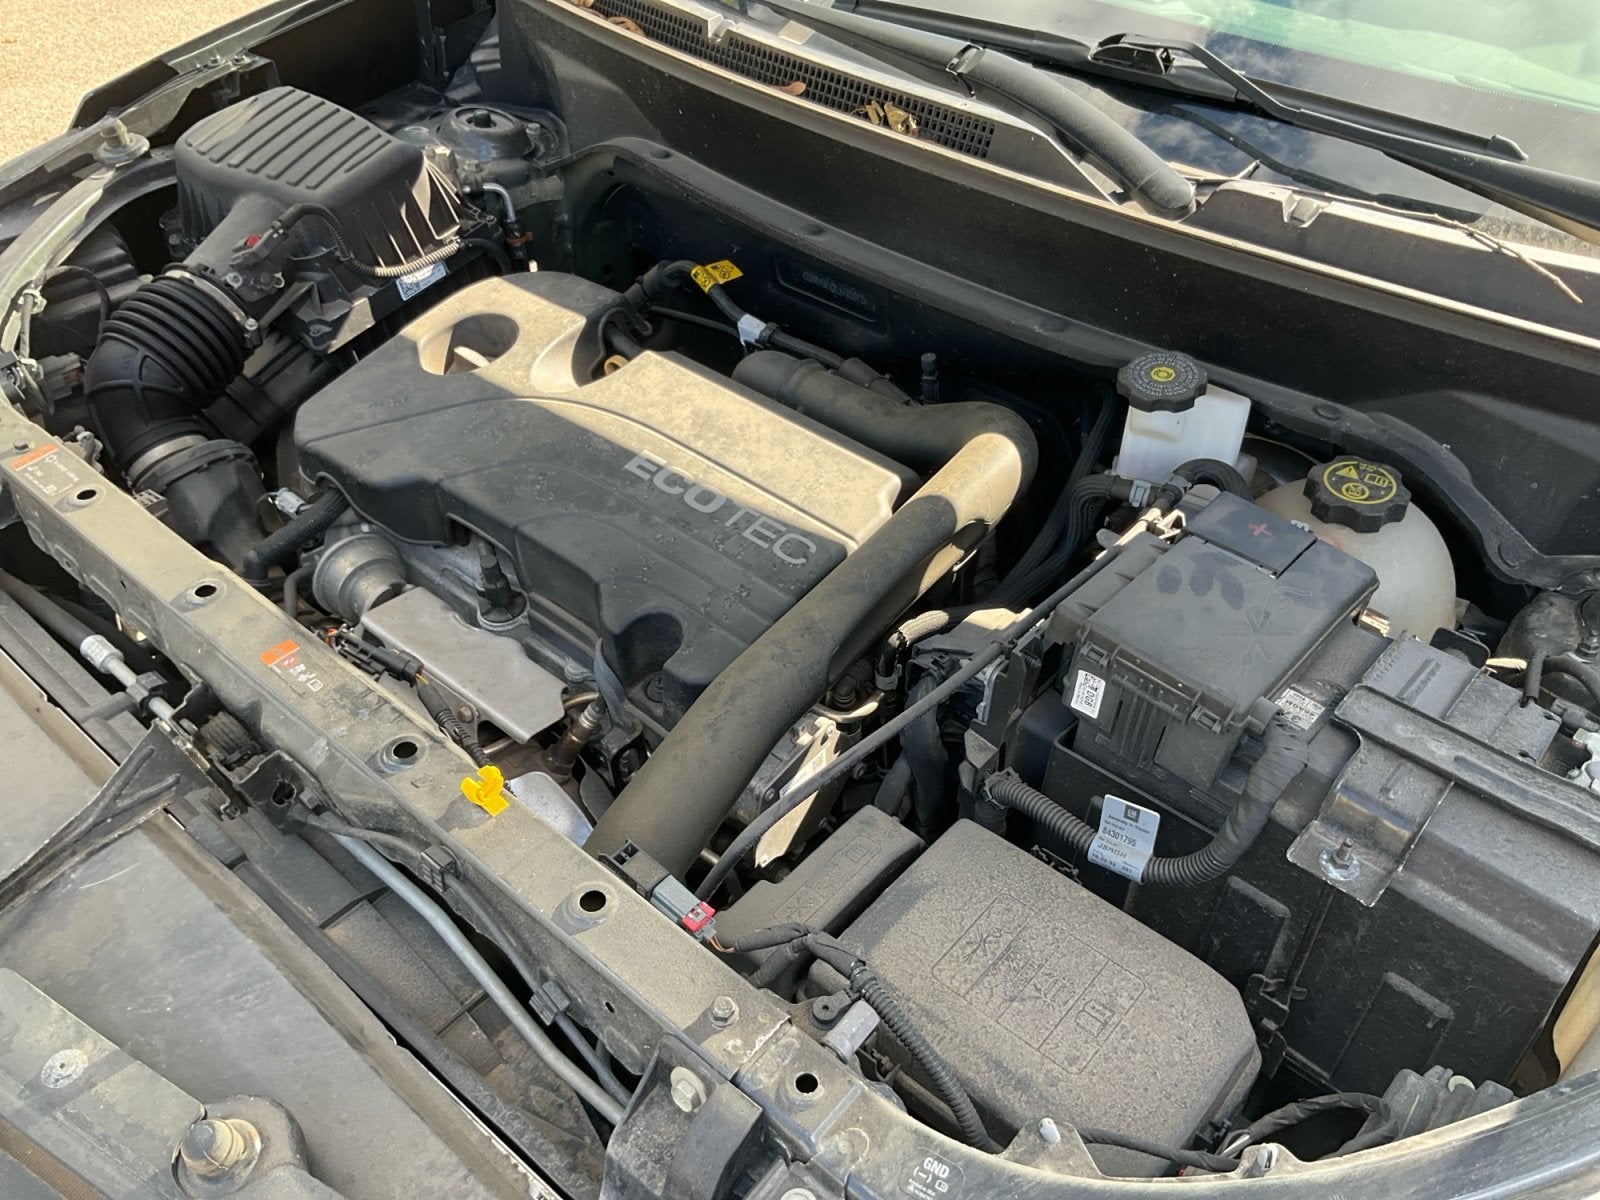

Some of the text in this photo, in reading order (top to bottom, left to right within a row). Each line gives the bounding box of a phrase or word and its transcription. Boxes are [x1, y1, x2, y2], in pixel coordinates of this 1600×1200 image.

[623, 449, 817, 565] ECOTEC
[1127, 808, 1138, 818] GM
[1102, 826, 1137, 847] 84301795
[923, 1156, 950, 1178] GND
